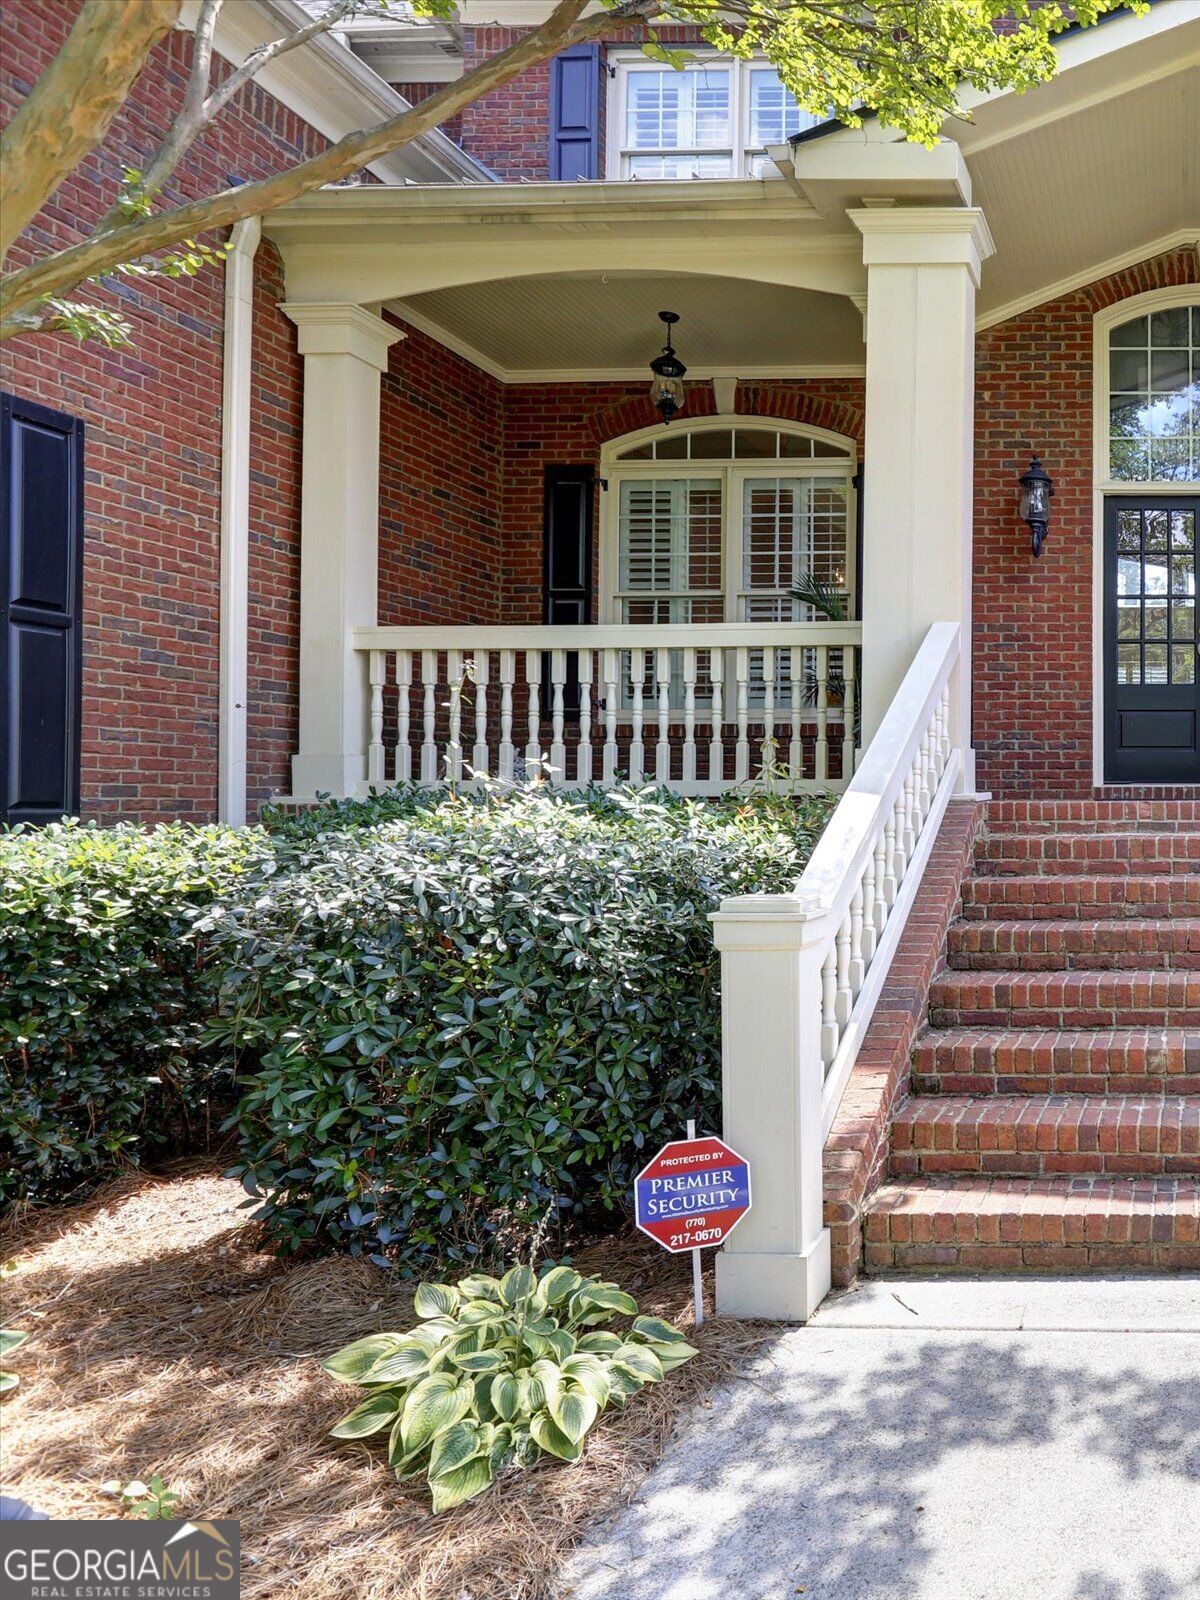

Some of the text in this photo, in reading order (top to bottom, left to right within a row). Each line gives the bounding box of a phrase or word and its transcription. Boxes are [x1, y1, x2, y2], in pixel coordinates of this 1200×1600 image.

[660, 1151, 724, 1167] PROTECTED BY
[650, 1170, 735, 1195] PREMIER
[647, 1187, 740, 1216] SECURITY
[685, 1216, 706, 1229] (770)
[670, 1227, 722, 1246] 217-0670
